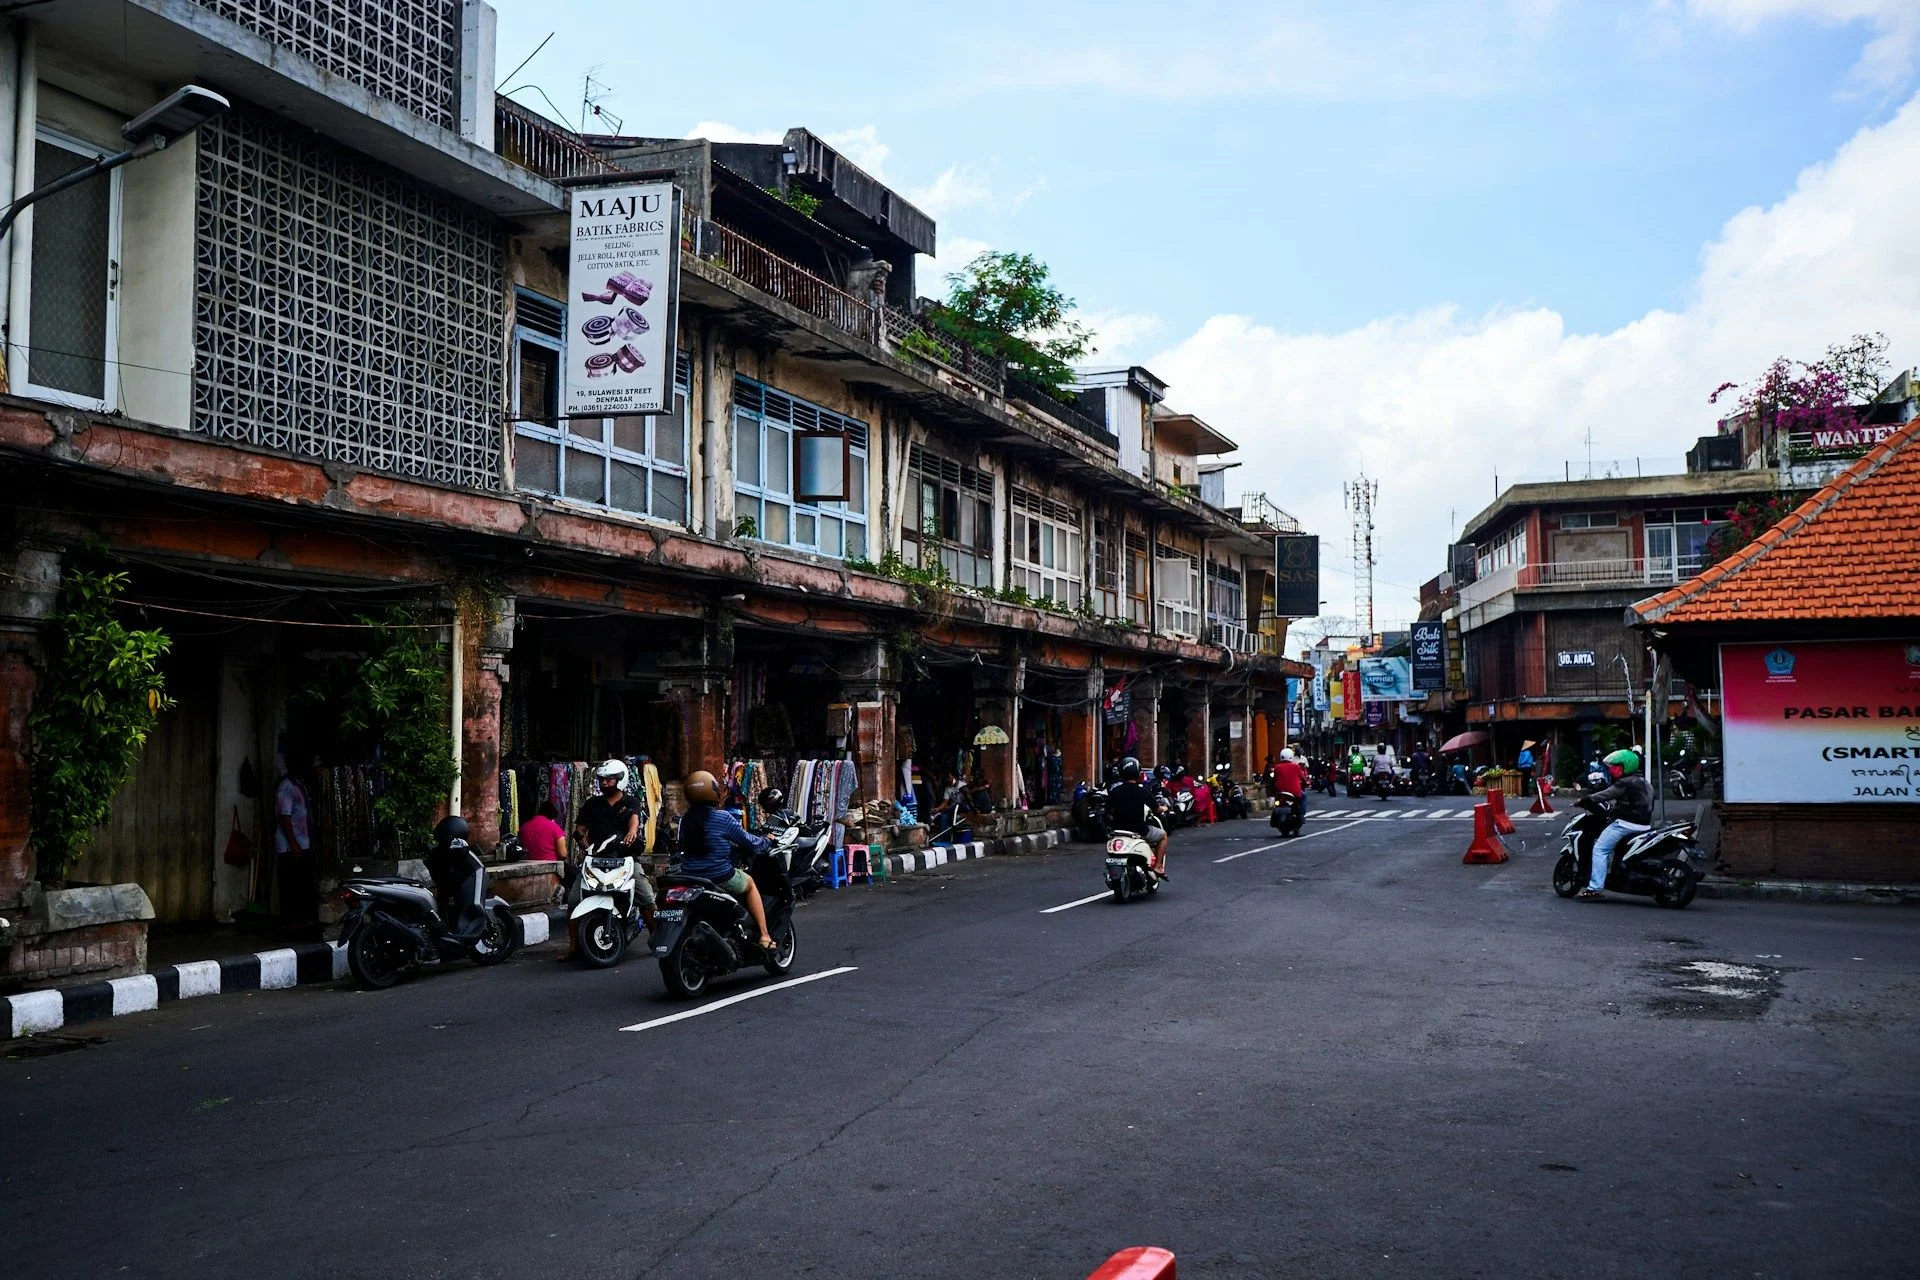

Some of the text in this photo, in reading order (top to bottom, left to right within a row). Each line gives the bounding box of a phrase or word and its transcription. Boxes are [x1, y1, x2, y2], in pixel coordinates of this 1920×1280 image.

[579, 194, 661, 220] MAJU
[577, 221, 664, 236] BATIK FABRICS
[604, 241, 632, 249] SELLING
[577, 253, 597, 262] JELLY
[597, 252, 615, 260] ROLL,
[628, 249, 661, 258] QUARTER,
[587, 262, 614, 270] COTTON
[614, 260, 635, 268] BATIK,
[588, 389, 623, 397] SULAWESI
[625, 387, 652, 395] STREET
[581, 404, 602, 412] (0361)
[1278, 569, 1318, 583] SAS
[1414, 626, 1441, 641] Bali
[1416, 641, 1440, 655] Silk
[1560, 654, 1592, 664] UD. ARTA
[1784, 706, 1870, 719] PASAR
[1853, 787, 1909, 797] JALAN
